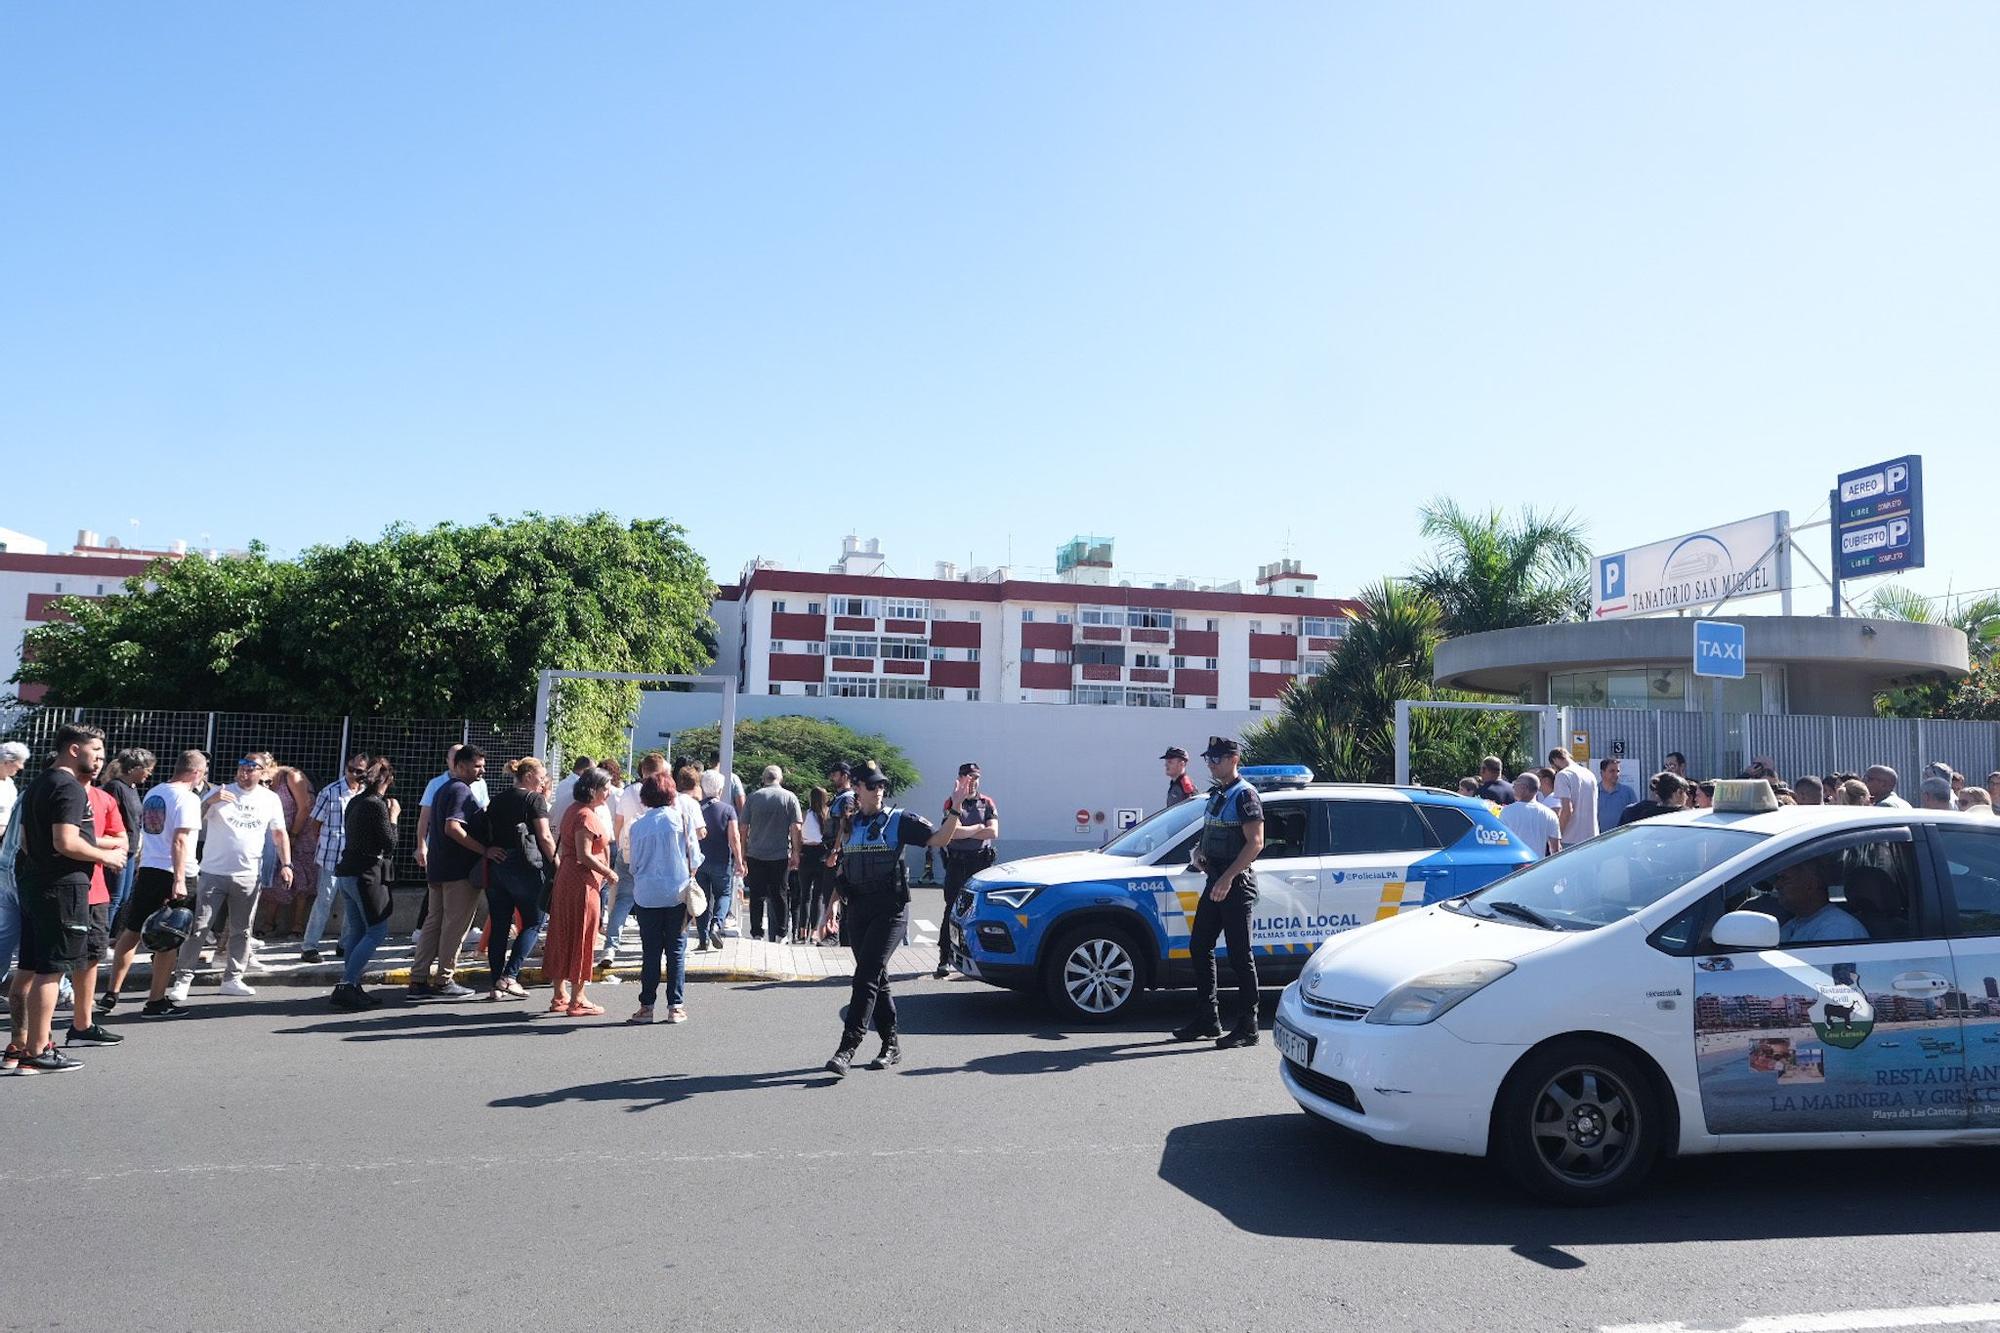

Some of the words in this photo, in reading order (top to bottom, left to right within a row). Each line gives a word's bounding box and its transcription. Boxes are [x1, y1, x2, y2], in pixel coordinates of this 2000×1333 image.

[1848, 479, 1877, 495] AEREO
[1887, 466, 1906, 492] P
[1850, 507, 1869, 517] LIBRE
[1877, 499, 1902, 511] COMPLETO
[1843, 530, 1885, 549] CUBIERTO
[1889, 520, 1907, 546] P
[1851, 558, 1870, 568] LIBRE
[1878, 552, 1903, 563] COMPLETO
[1606, 562, 1620, 595] P
[1632, 583, 1691, 612] TANATORIO
[1695, 577, 1718, 600] SAN
[1699, 640, 1742, 660] TAXI
[1615, 742, 1623, 753] 3
[1119, 811, 1136, 829] P
[1481, 830, 1508, 841] 092
[1346, 871, 1399, 881] @PoliciaLPA
[1127, 881, 1166, 892] R-044
[1307, 914, 1361, 929] LOCAL
[1253, 931, 1285, 940] PALMAS
[1287, 930, 1298, 938] DE
[1300, 929, 1322, 938] GRAN
[1875, 1064, 2000, 1086] RESTAURAN
[1771, 1096, 1797, 1112] LA
[1801, 1091, 1906, 1111] MARINERA
[1914, 1090, 1927, 1106] Y
[1873, 1110, 1897, 1119] Playa
[1899, 1108, 1911, 1117] de
[1911, 1107, 1925, 1117] Las
[1926, 1107, 1968, 1116] Canteras
